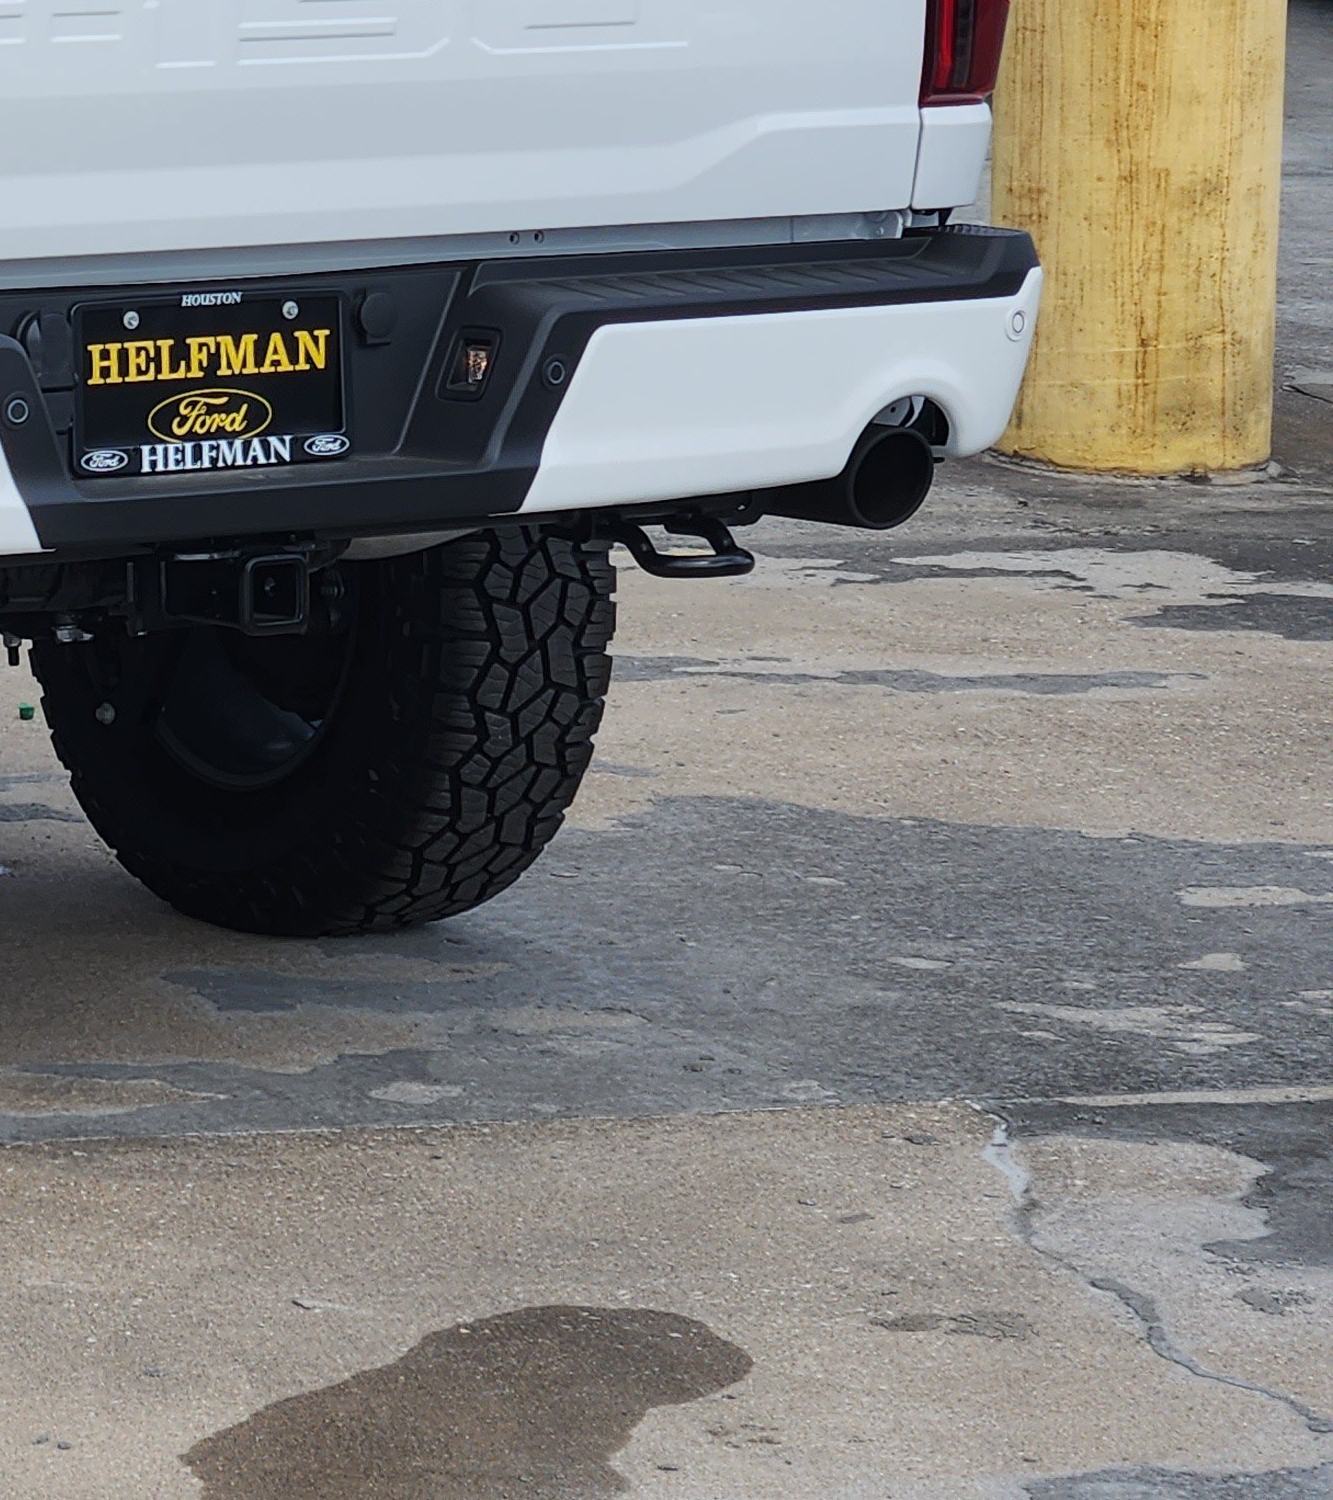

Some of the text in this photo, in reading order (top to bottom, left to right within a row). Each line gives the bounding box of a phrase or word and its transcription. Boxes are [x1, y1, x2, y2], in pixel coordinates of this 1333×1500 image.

[181, 291, 243, 307] HOUSTON
[87, 329, 331, 385] HELFMAN
[171, 396, 249, 436] Ford
[140, 435, 293, 473] HELFMAN
[313, 437, 342, 453] Ford
[89, 452, 120, 469] Ford
